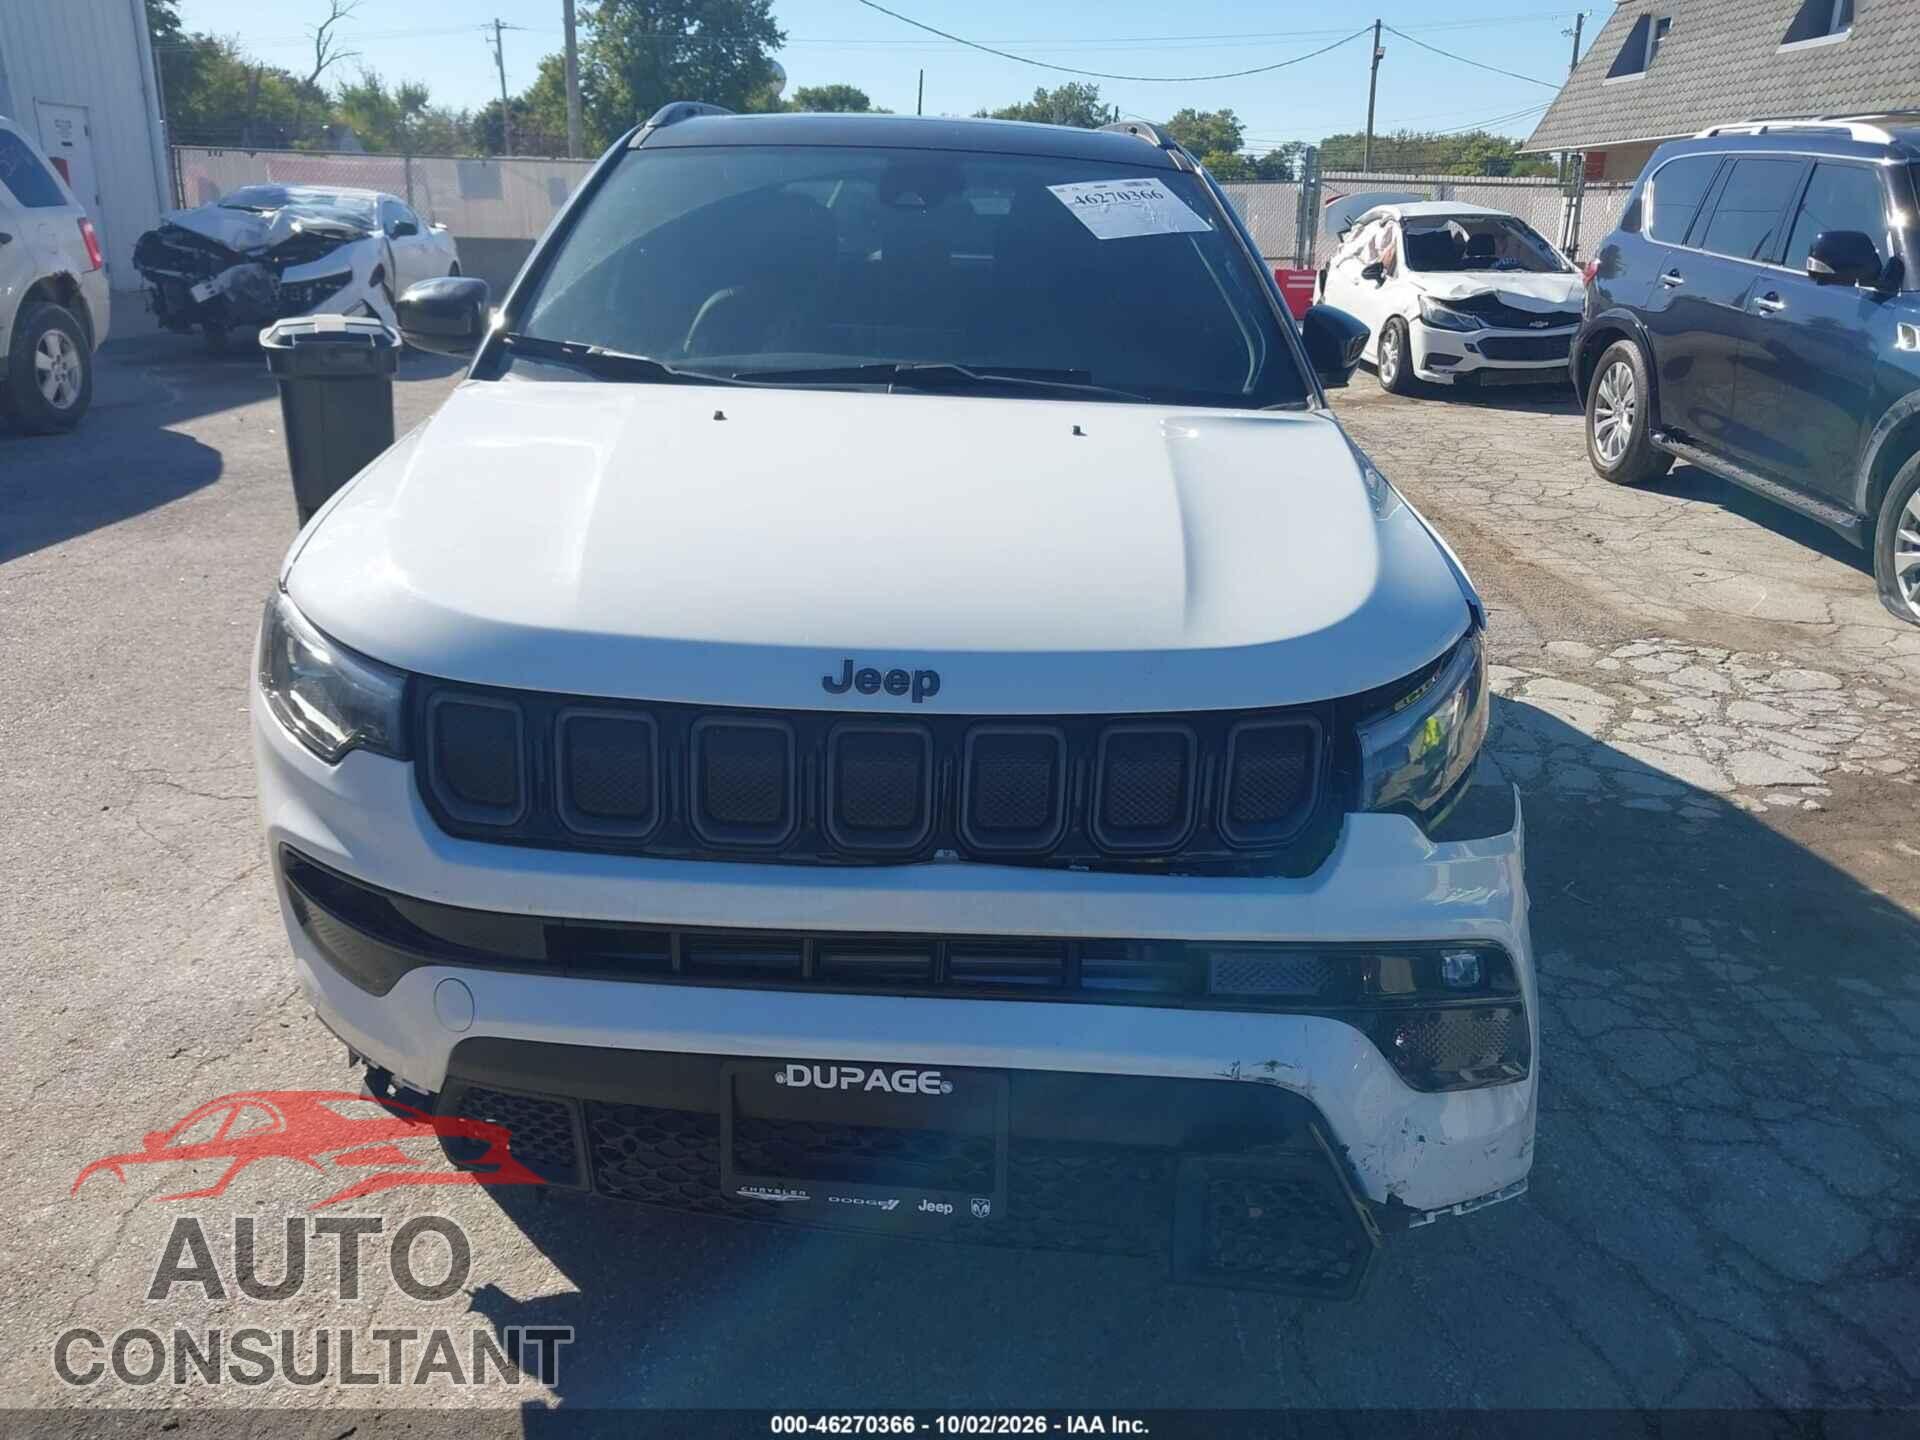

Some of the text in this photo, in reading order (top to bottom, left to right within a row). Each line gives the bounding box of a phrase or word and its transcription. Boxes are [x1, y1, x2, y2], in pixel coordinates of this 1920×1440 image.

[1073, 189, 1164, 206] 46270366
[822, 659, 941, 703] Jeep
[786, 1064, 942, 1094] DUPAGE
[741, 1186, 807, 1196] CHRYSLER
[918, 1200, 952, 1215] Jeep
